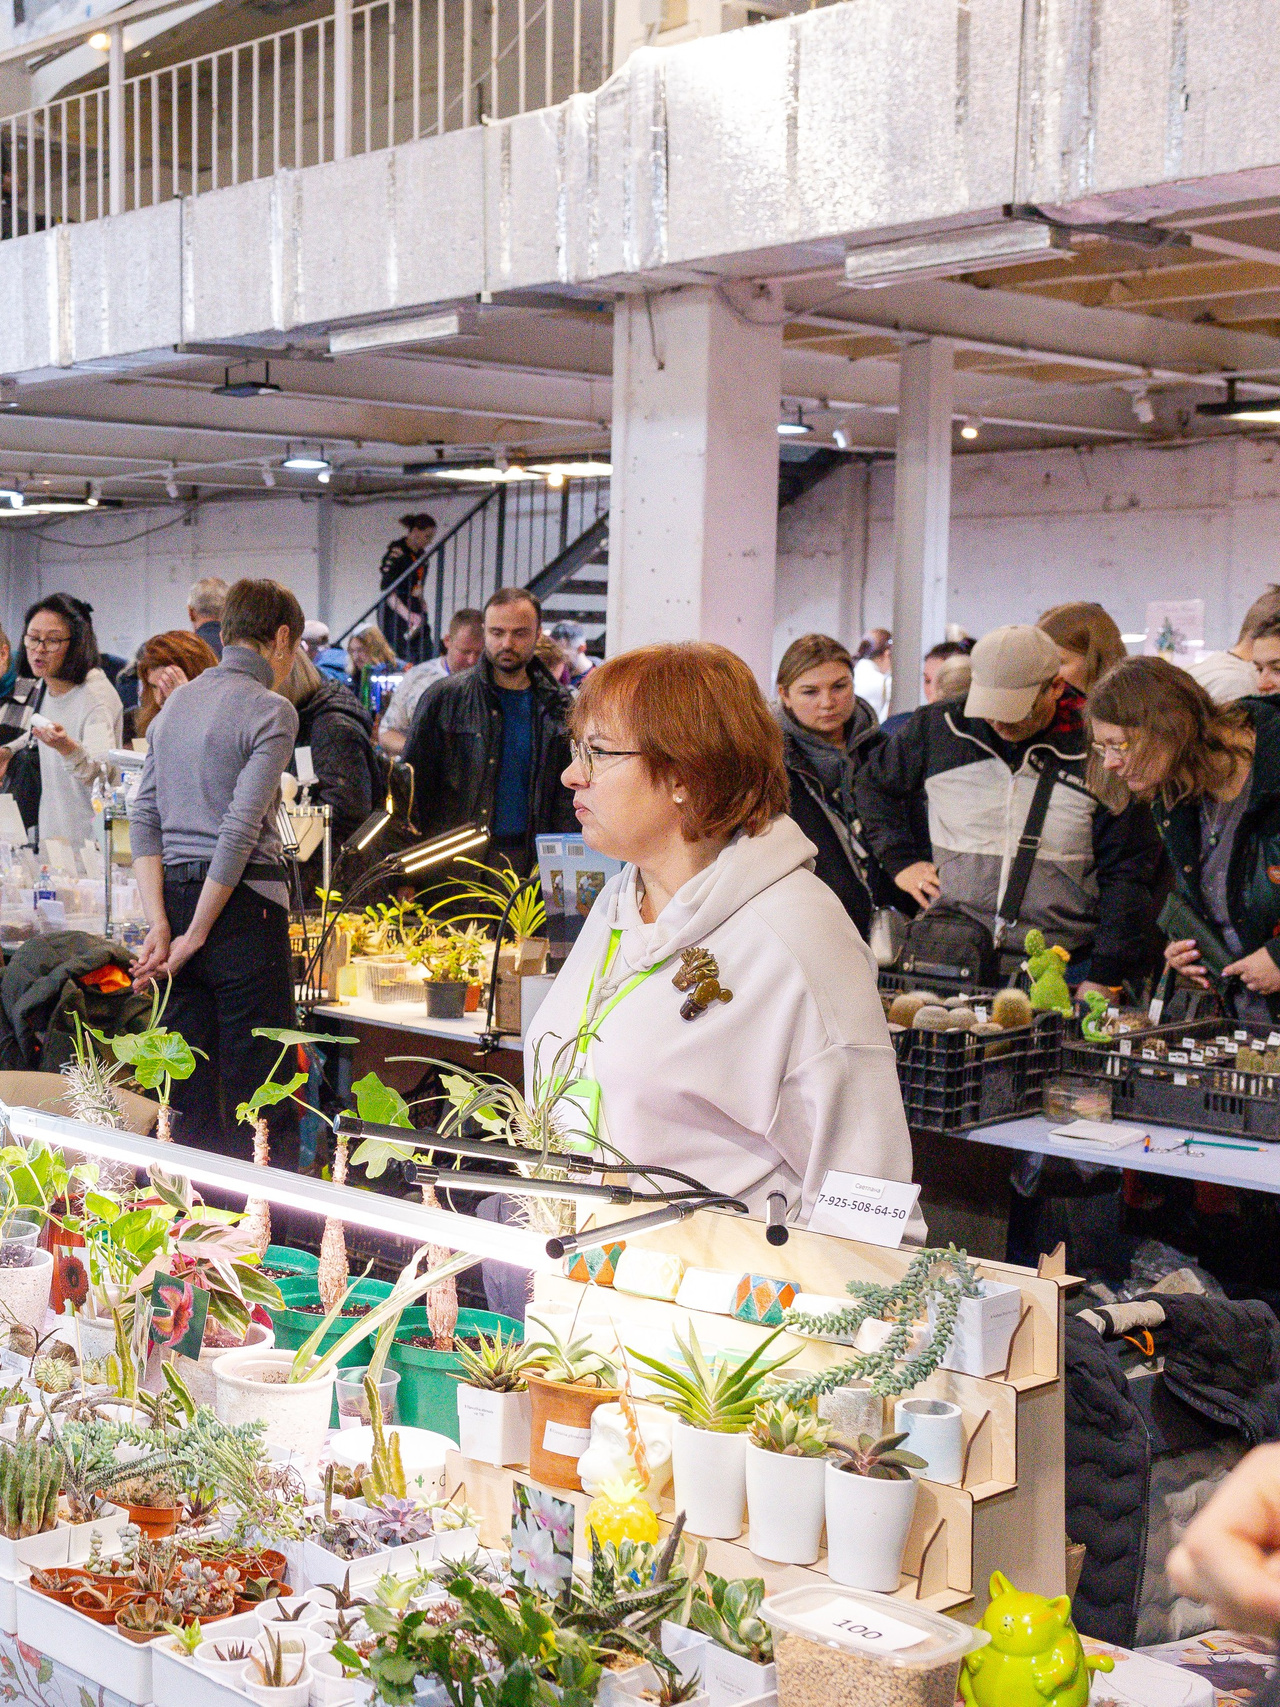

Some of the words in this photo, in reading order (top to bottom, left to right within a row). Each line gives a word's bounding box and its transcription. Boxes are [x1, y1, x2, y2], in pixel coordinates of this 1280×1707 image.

[854, 1182, 881, 1194] Светлана
[818, 1194, 907, 1220] 7-925-508-64-50
[832, 1618, 883, 1640] 100
